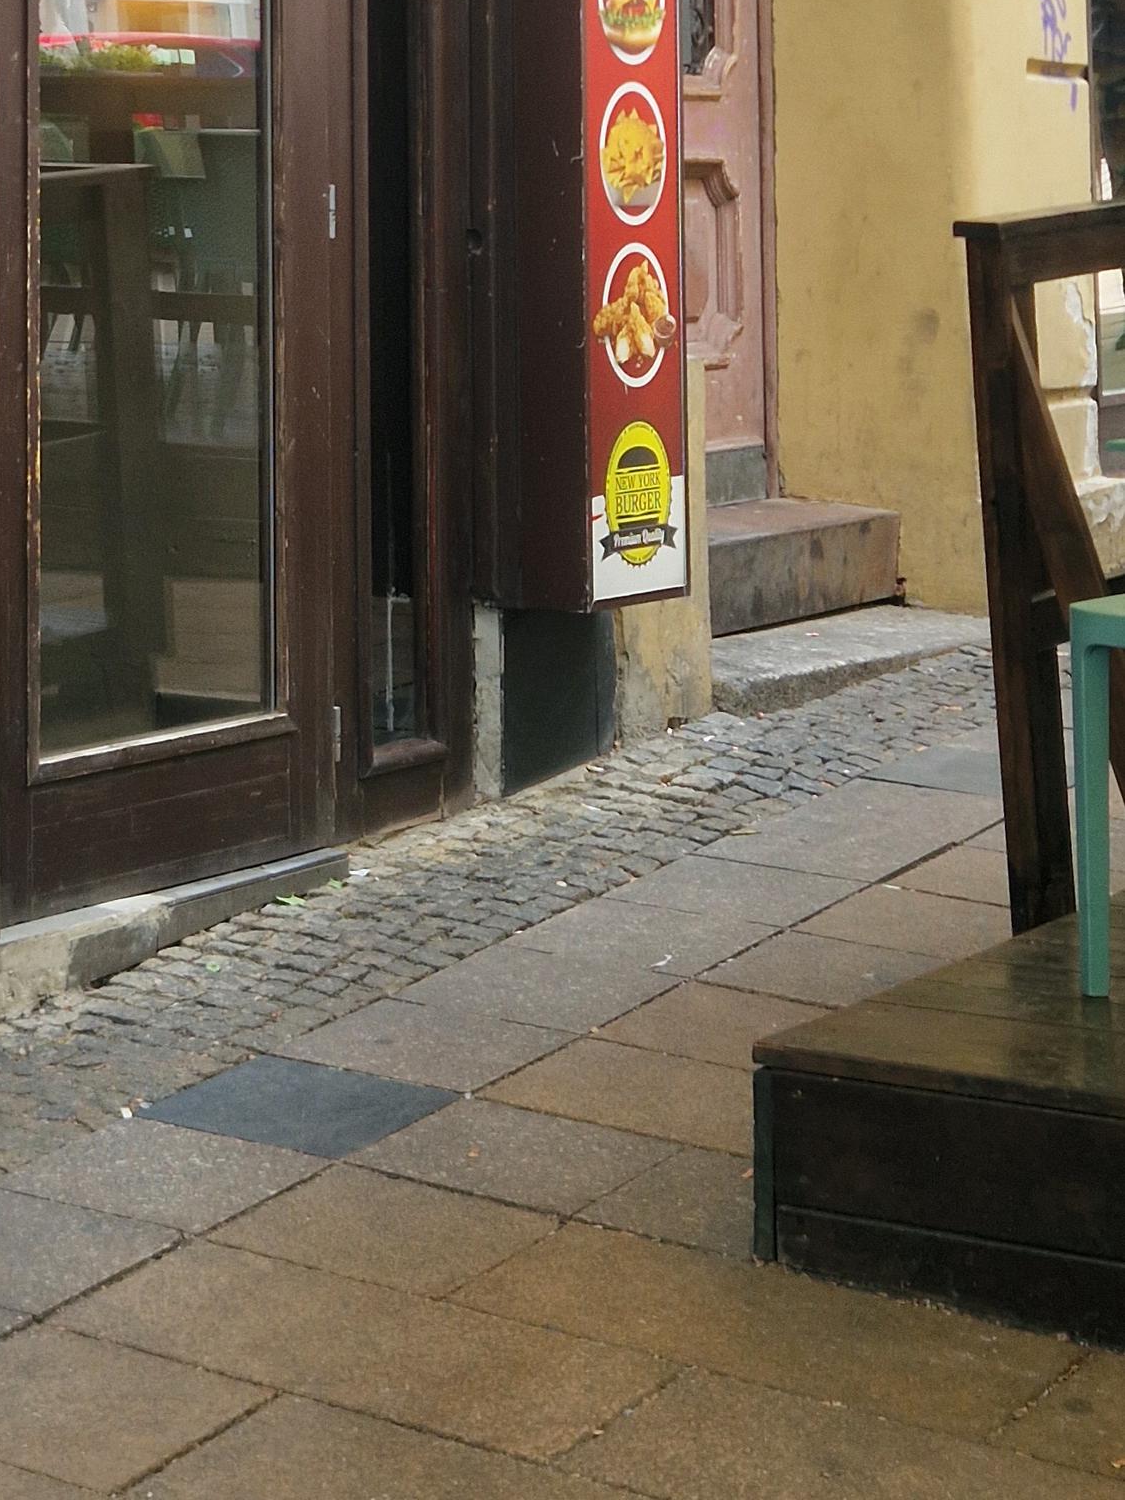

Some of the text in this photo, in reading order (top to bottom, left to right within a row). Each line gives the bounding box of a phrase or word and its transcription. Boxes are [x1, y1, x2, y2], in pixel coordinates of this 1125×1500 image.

[616, 471, 661, 490] NEW YORK
[616, 490, 661, 514] BURGER
